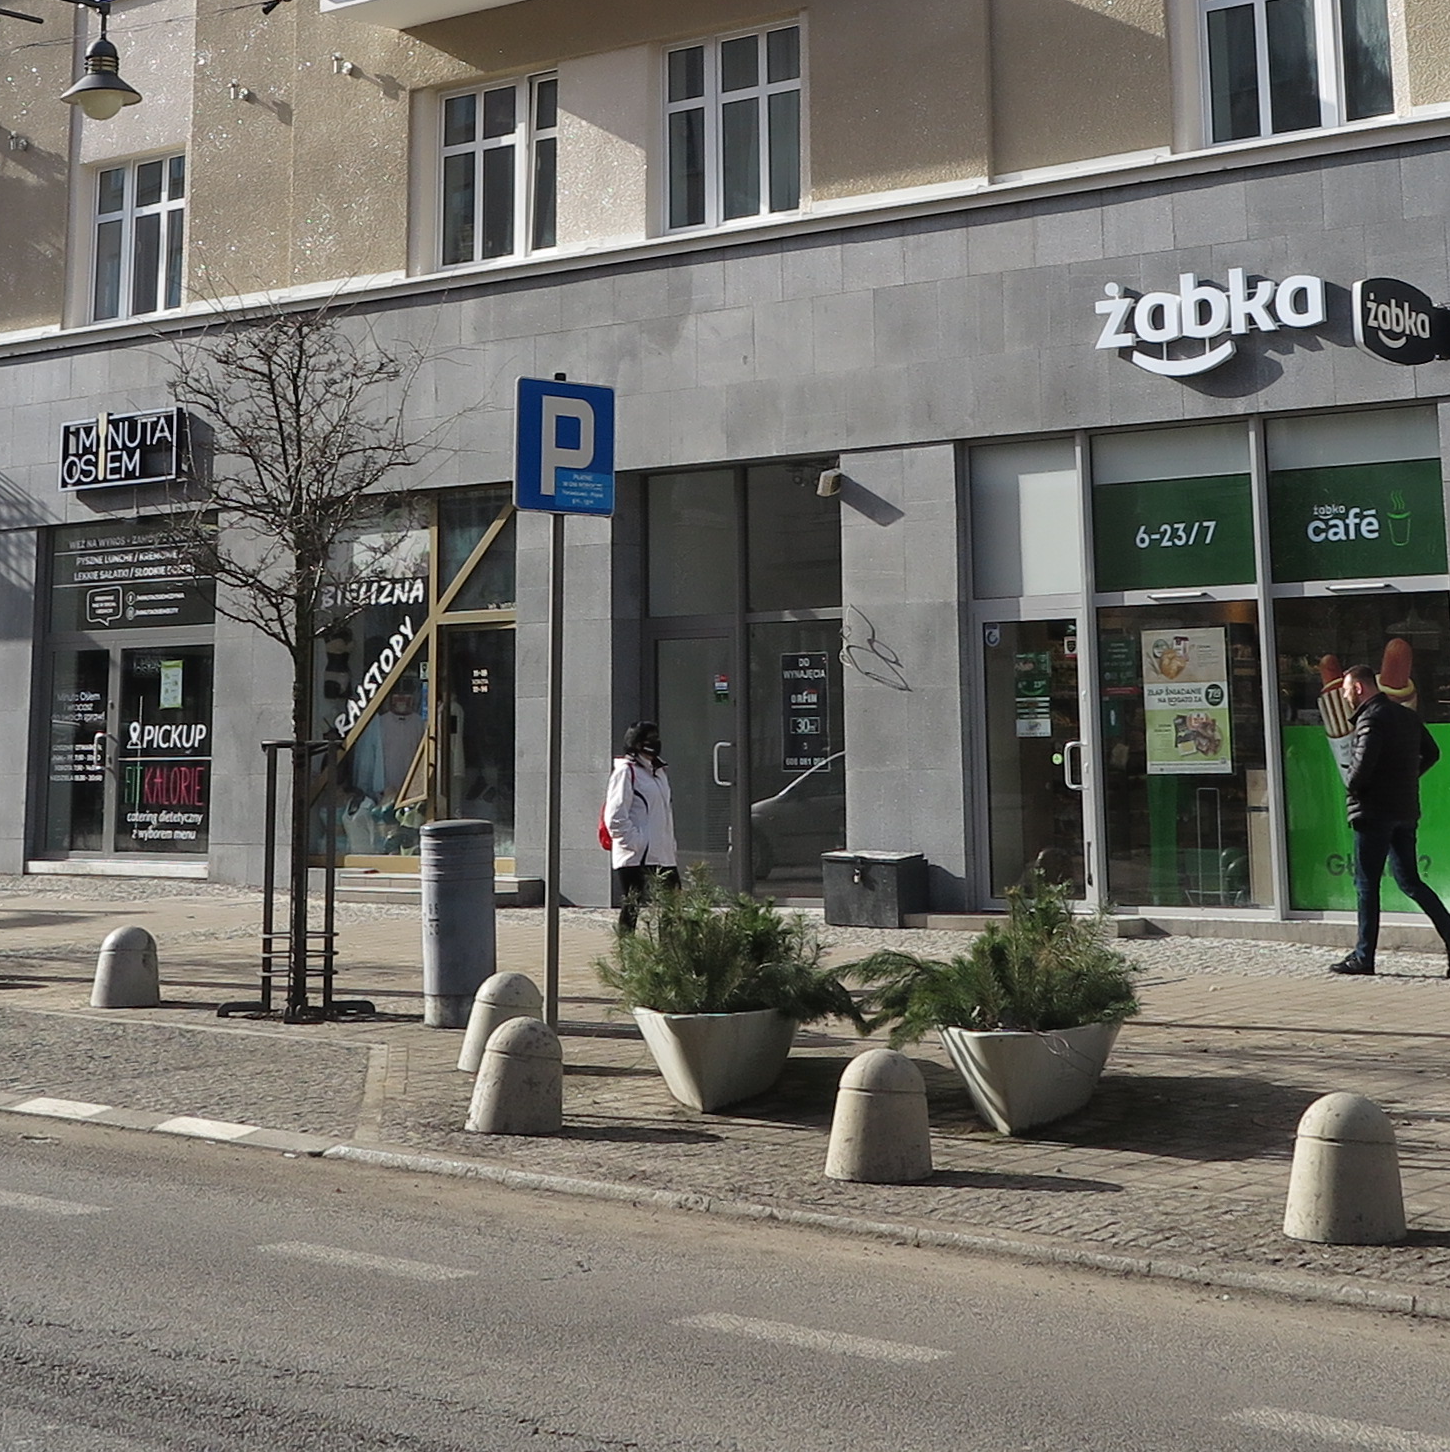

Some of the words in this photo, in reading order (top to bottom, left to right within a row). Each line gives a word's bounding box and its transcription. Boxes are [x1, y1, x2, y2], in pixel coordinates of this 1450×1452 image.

[1094, 267, 1328, 350] żabka
[1365, 292, 1431, 340] żabka
[539, 394, 596, 496] P
[1313, 503, 1346, 517] żabka
[1135, 521, 1217, 549] 6-23/7
[321, 578, 425, 609] BIELIZNA
[334, 615, 415, 738] RAJSTOPY
[783, 669, 826, 680] WYNAJĘCIA
[798, 658, 811, 667] DO
[143, 723, 207, 749] PICKUP
